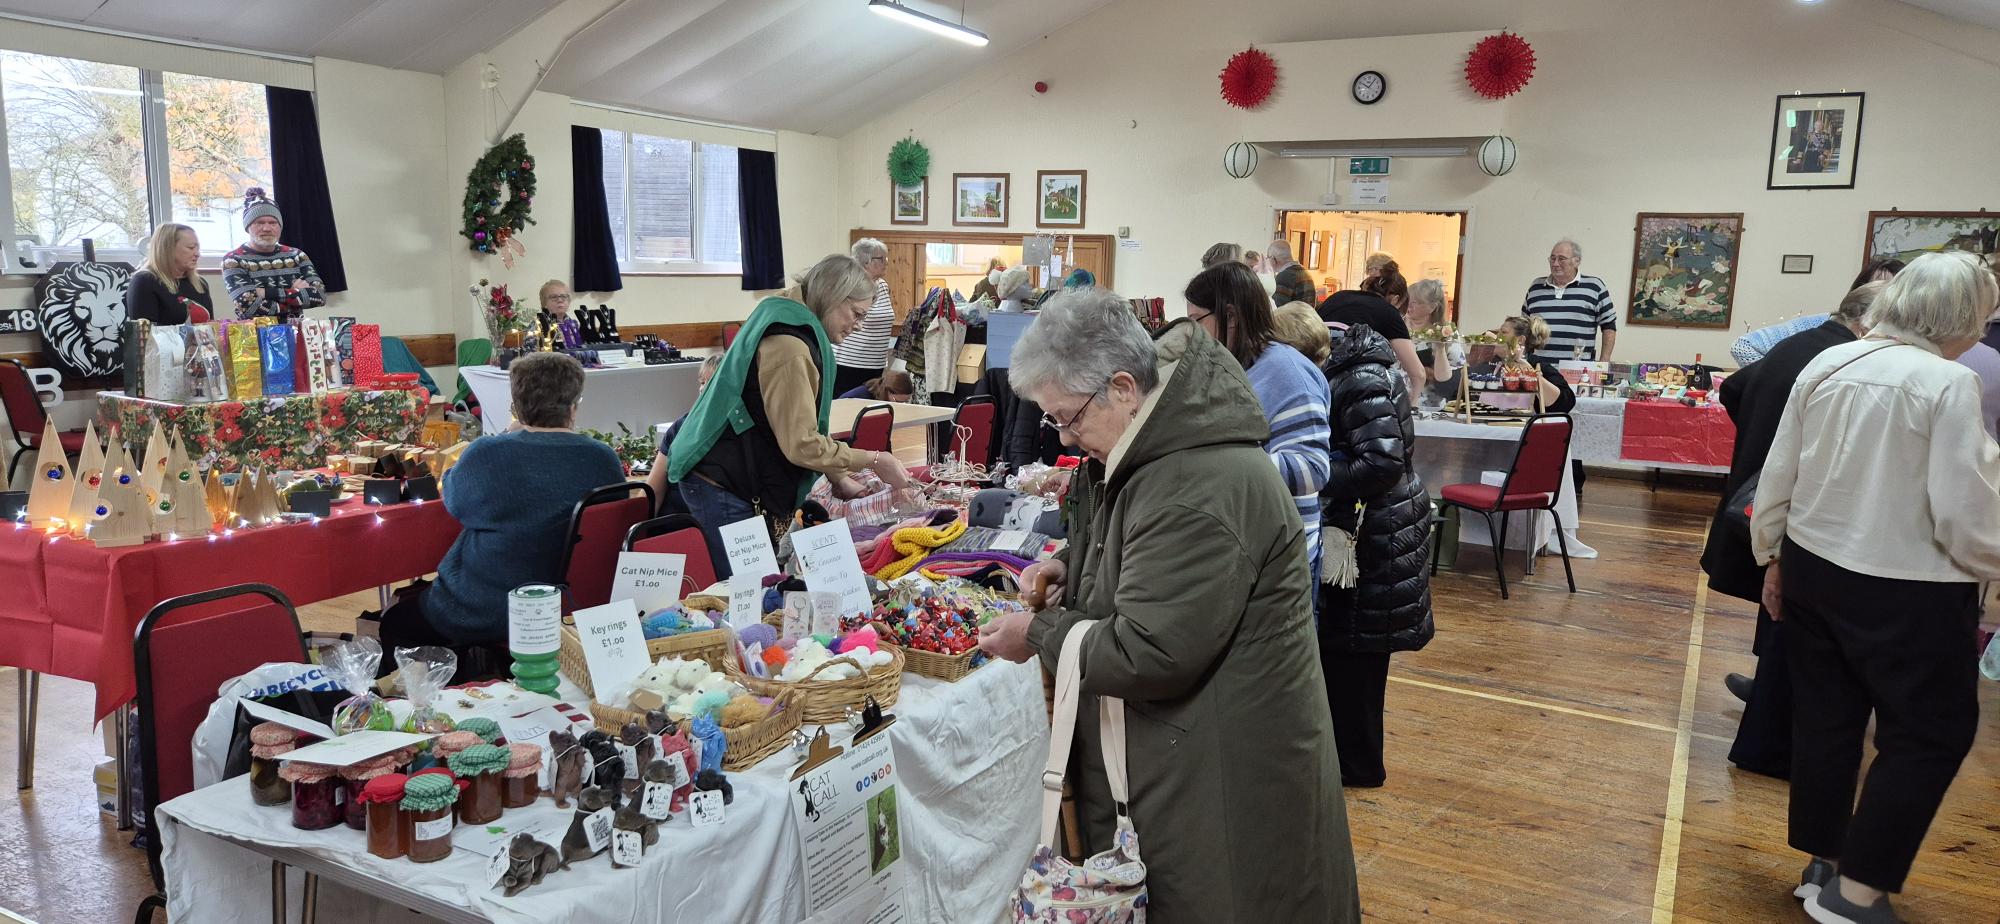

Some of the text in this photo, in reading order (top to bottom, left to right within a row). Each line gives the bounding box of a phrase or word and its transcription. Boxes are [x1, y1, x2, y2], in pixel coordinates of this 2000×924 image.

[734, 534, 756, 544] Deluxe
[729, 542, 768, 559] Cat Nip Mice
[743, 556, 760, 566] £2.00
[621, 567, 678, 577] Cat Nip Mice
[635, 579, 660, 588] £1.00
[737, 602, 751, 612] £1.00
[591, 620, 628, 636] Key rings
[601, 636, 625, 648] £1.00
[809, 769, 831, 791] CAT
[813, 784, 841, 807] CALL
